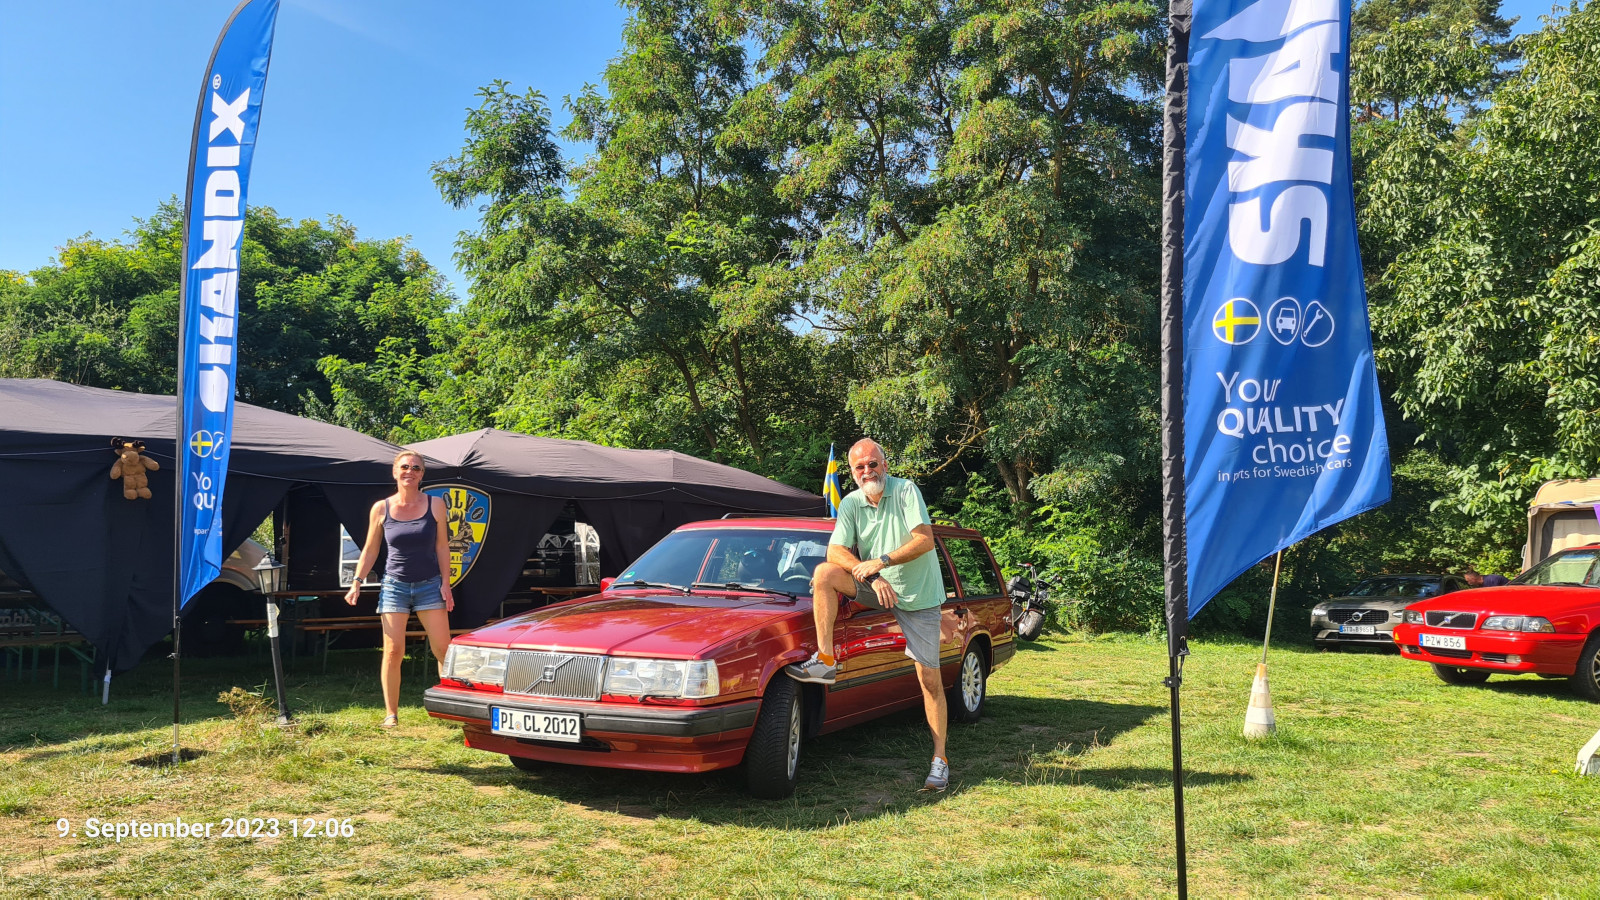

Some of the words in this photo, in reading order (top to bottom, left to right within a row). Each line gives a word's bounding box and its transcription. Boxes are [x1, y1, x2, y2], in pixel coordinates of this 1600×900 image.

[1217, 398, 1344, 439] QUALITY
[1252, 433, 1350, 464] choice
[1218, 470, 1230, 482] in
[1253, 466, 1271, 479] for
[1274, 463, 1325, 478] Swedish
[1326, 457, 1352, 470] cars
[443, 490, 484, 521] OLVO
[1425, 635, 1441, 646] PZW
[1444, 637, 1461, 648] 856
[501, 711, 514, 730] PI
[523, 714, 540, 732] CL
[543, 716, 577, 736] 2012
